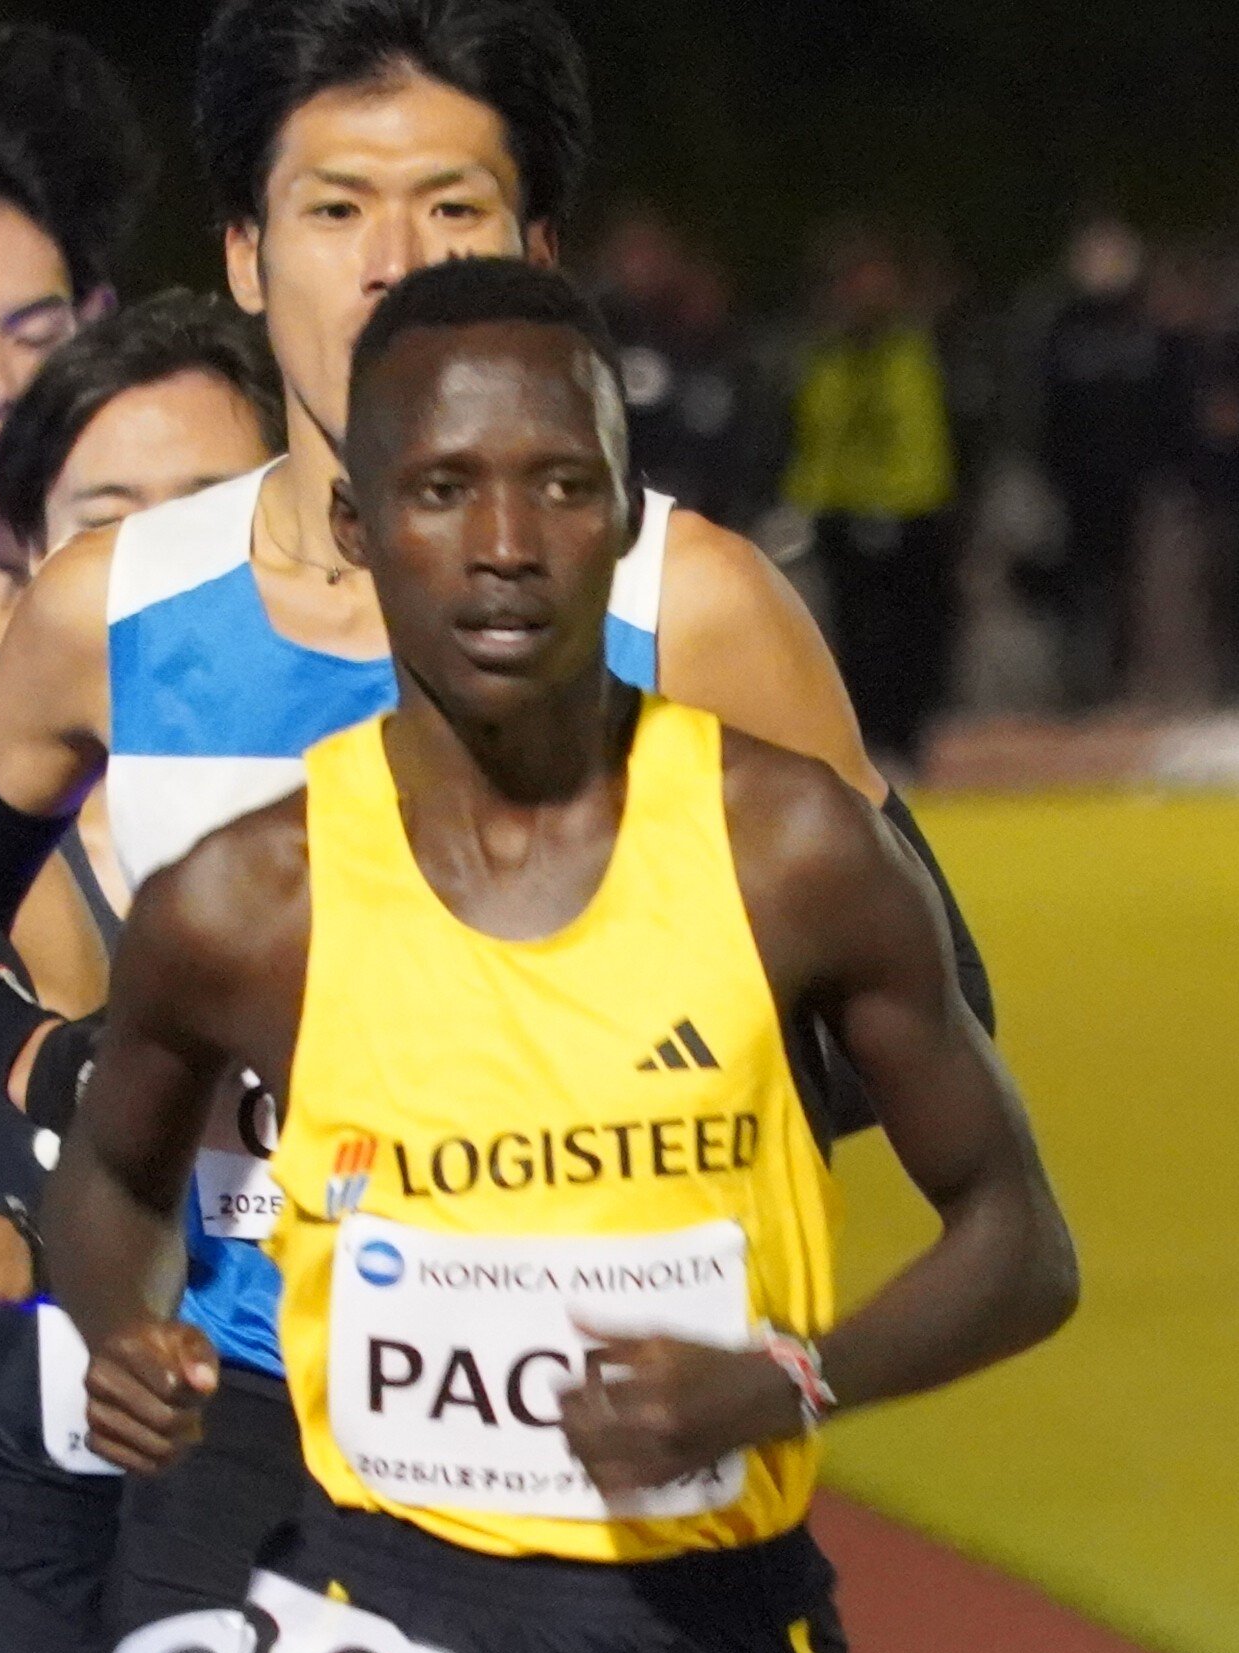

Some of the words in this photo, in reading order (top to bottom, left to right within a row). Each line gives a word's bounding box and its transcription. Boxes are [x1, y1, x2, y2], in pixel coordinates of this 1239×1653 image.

[392, 1112, 759, 1198] LOGISTEED
[418, 1258, 560, 1291] KONICA
[568, 1254, 726, 1293] MINOLTA
